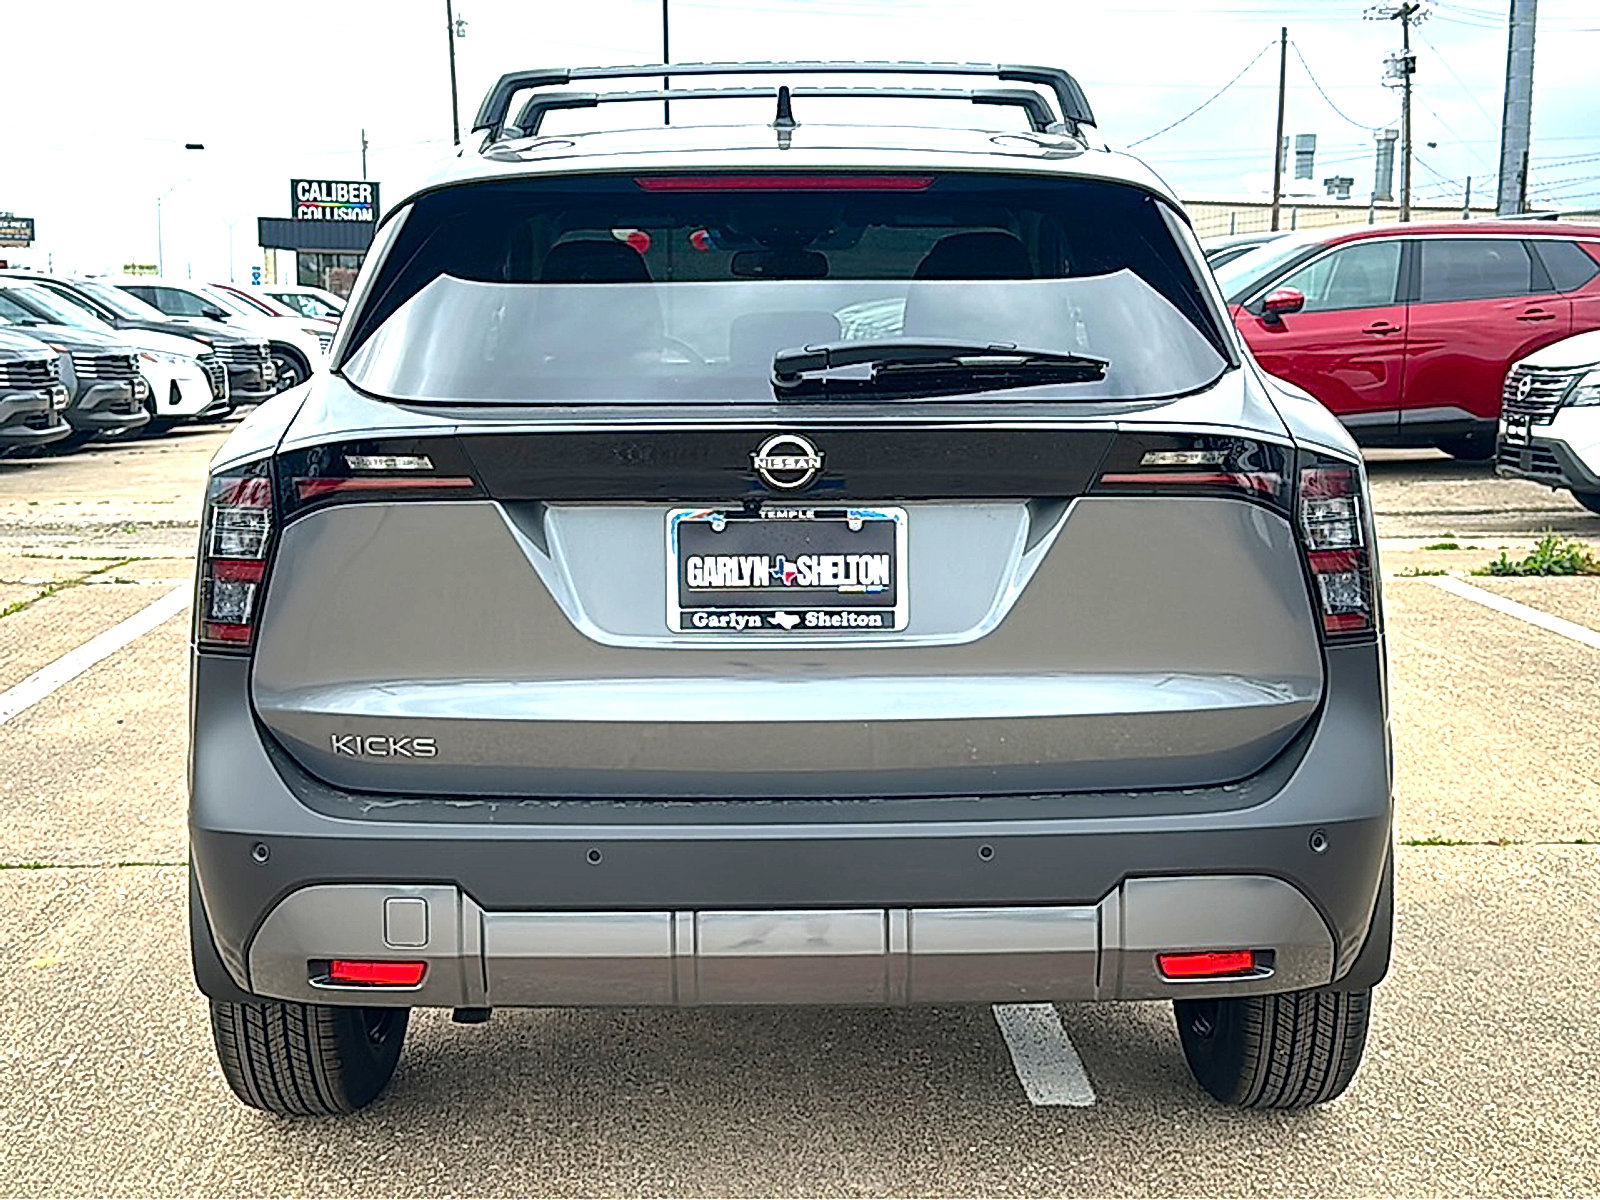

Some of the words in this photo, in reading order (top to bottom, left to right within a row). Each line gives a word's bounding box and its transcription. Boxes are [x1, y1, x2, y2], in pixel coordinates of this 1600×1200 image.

[297, 182, 372, 203] CALIBER
[754, 456, 822, 470] NISSAN
[759, 510, 816, 519] TEMPLE
[686, 556, 770, 587] GARLYN
[797, 555, 890, 585] SHELTON
[692, 612, 762, 631] Garlyn
[805, 612, 882, 627] Shelton
[331, 734, 438, 758] KICKS
